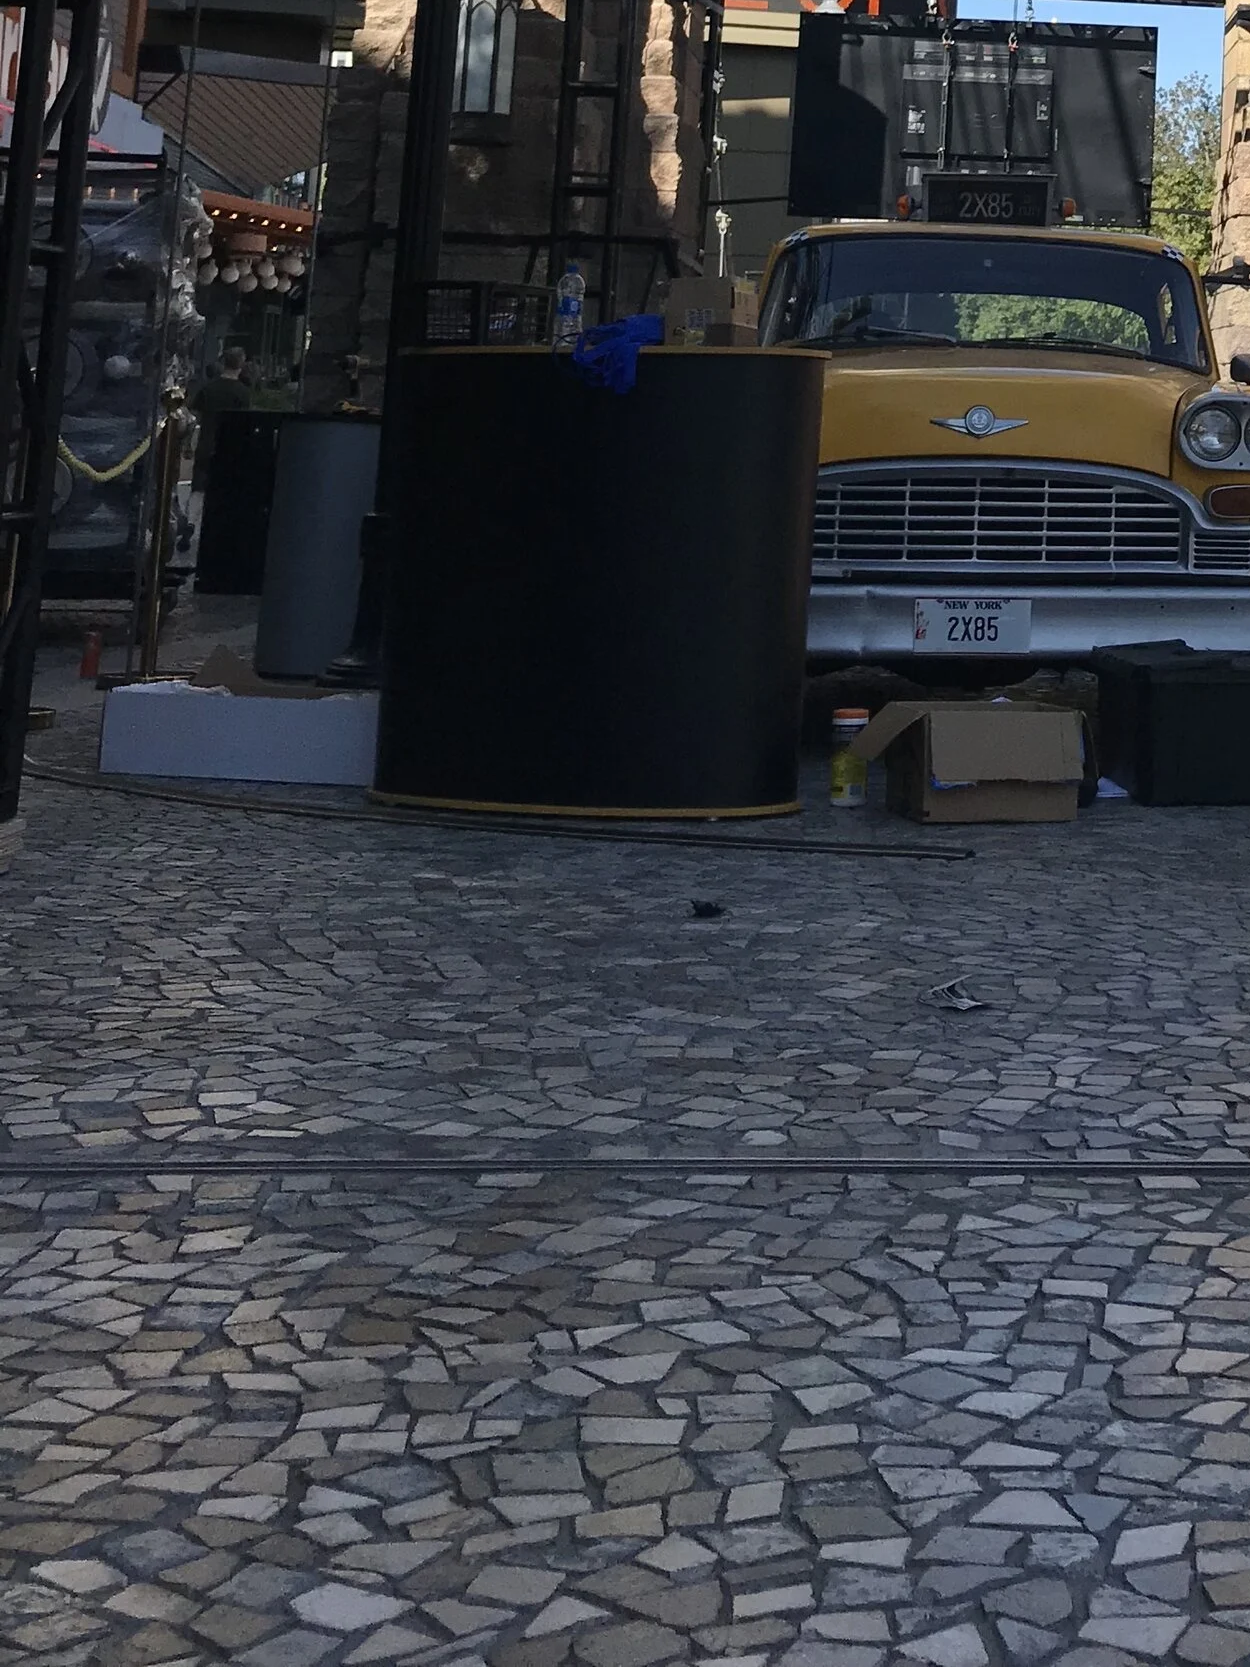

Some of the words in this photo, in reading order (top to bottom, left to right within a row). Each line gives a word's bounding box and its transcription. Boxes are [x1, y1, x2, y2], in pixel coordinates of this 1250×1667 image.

[959, 192, 1014, 218] 2X85
[944, 600, 969, 610] NEW
[974, 600, 1002, 610] YORK
[948, 616, 999, 642] 2X85
